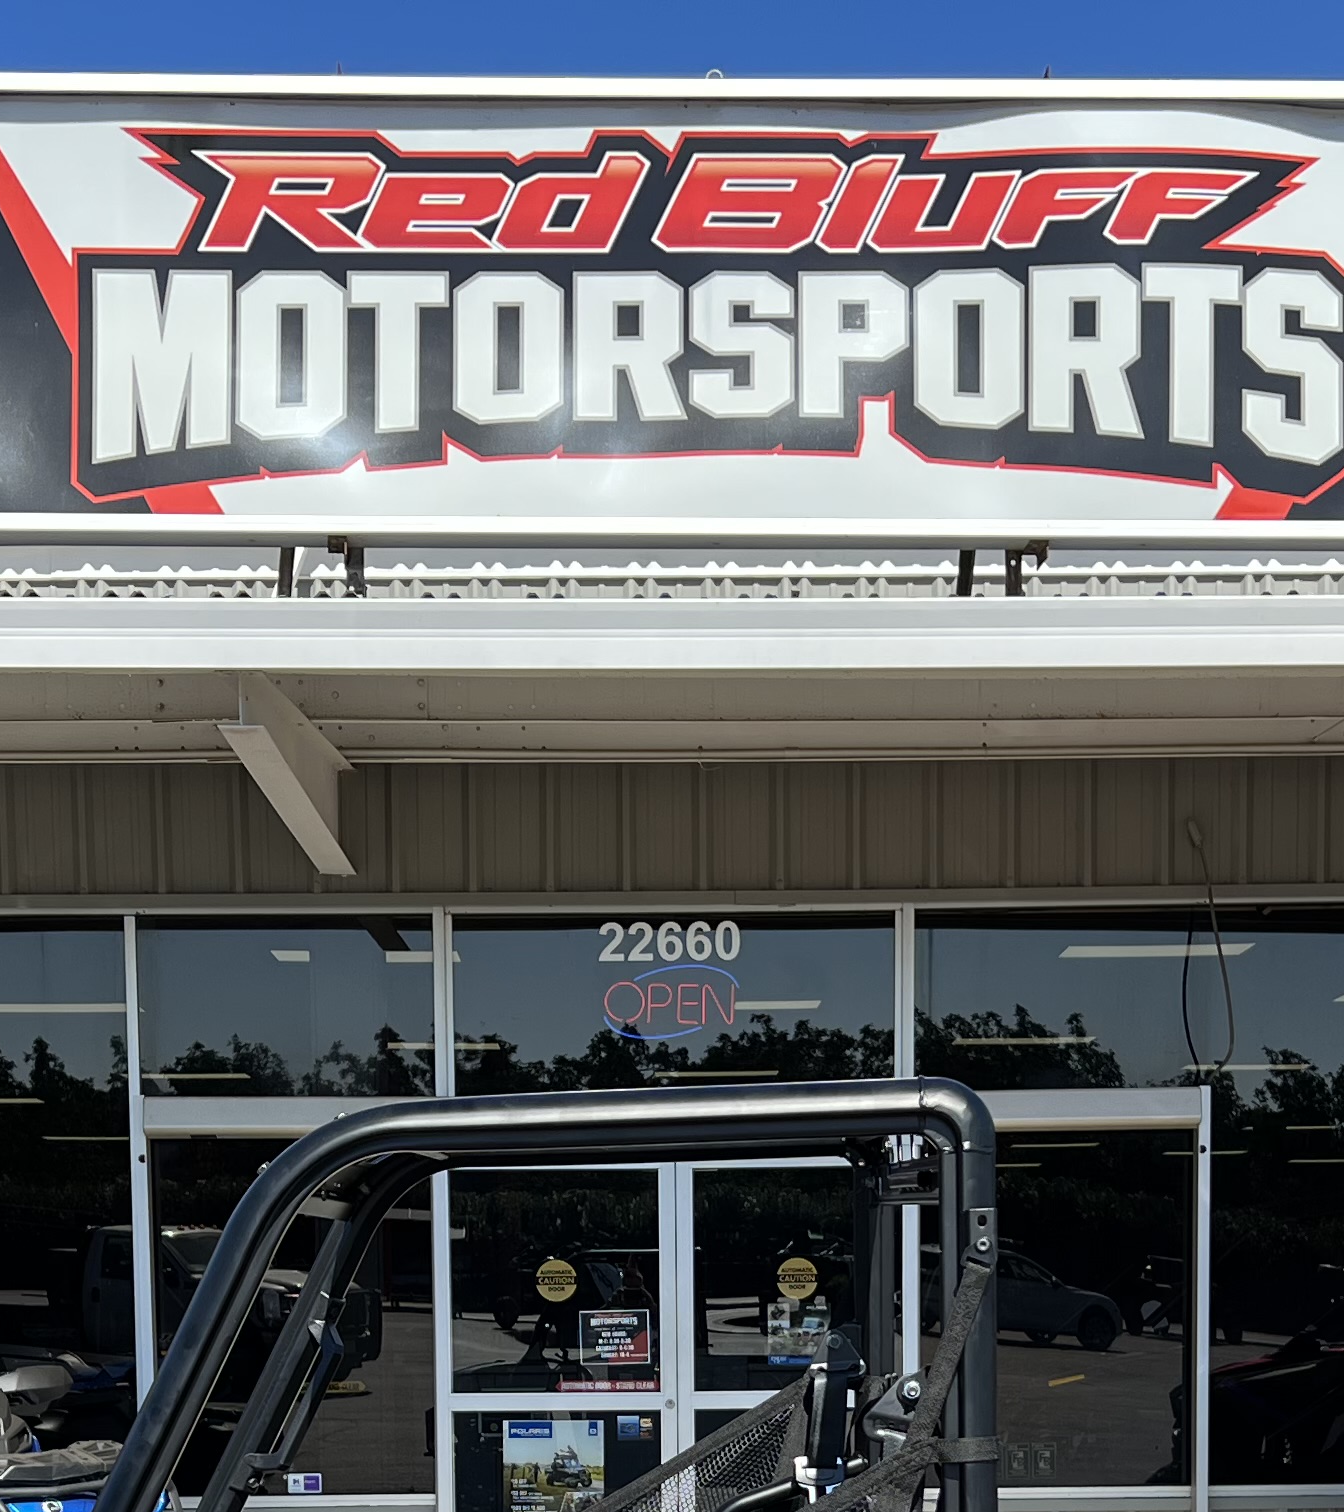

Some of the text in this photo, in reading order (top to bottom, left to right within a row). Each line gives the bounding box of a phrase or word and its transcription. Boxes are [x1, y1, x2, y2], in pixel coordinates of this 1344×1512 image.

[598, 920, 741, 963] 22660
[603, 981, 736, 1025] OPEN
[538, 1276, 575, 1285] CAUTION
[778, 1274, 816, 1282] CAUTION
